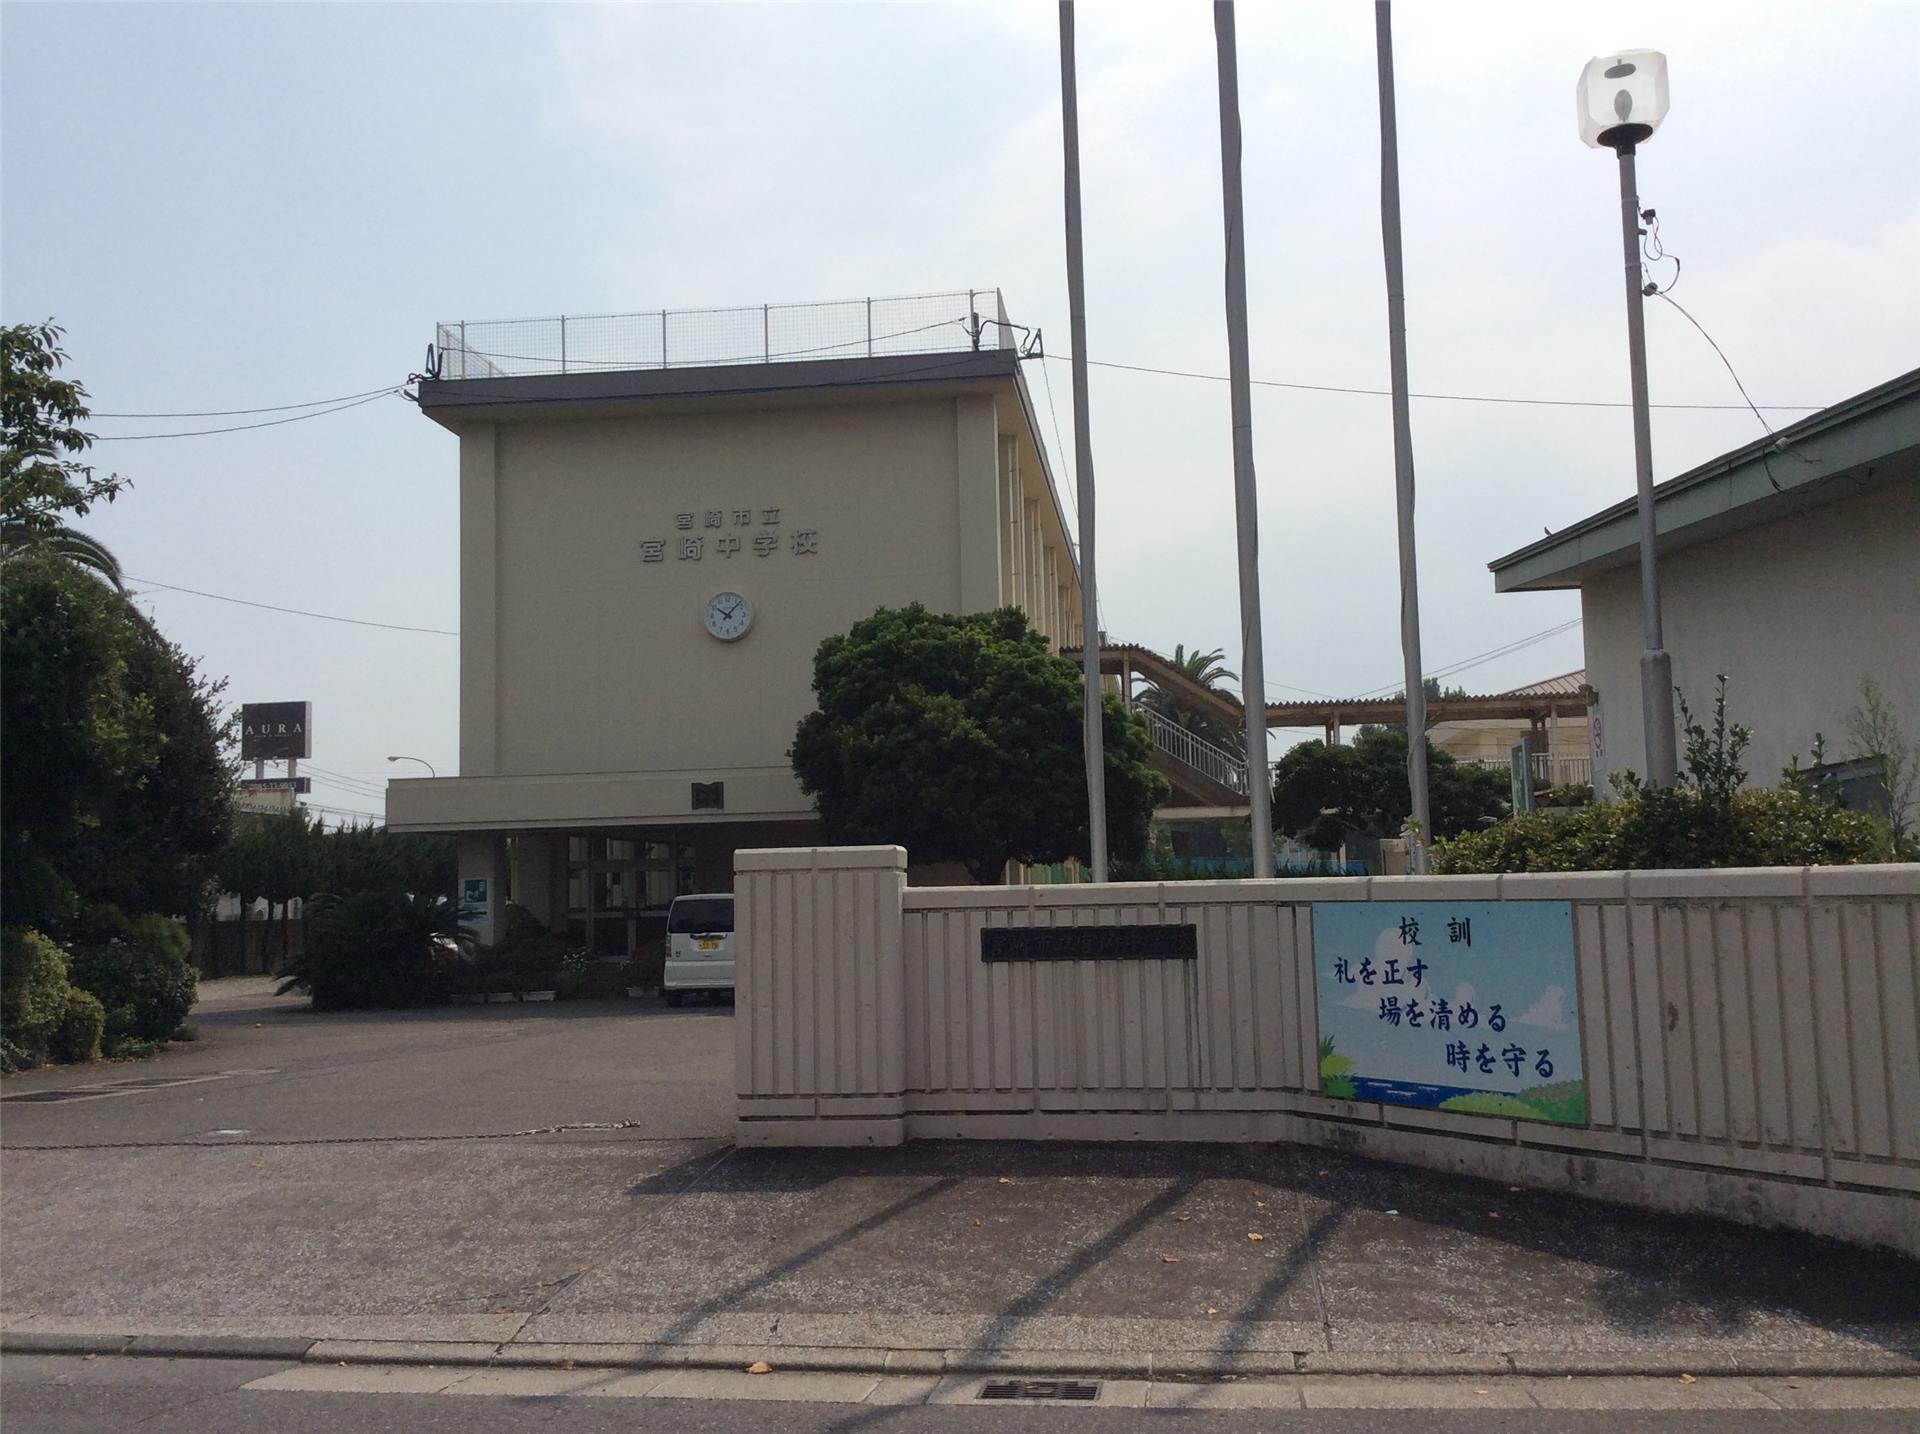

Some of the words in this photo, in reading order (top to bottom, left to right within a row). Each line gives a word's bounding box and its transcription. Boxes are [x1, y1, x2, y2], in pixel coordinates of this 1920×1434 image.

[676, 507, 780, 529] 宮崎市立
[640, 529, 818, 562] 宮崎中学校
[245, 723, 302, 735] AURA
[1334, 956, 1429, 987] 礼を正す
[1379, 996, 1506, 1033] 場を清める
[1446, 1040, 1554, 1079] 時を守る
